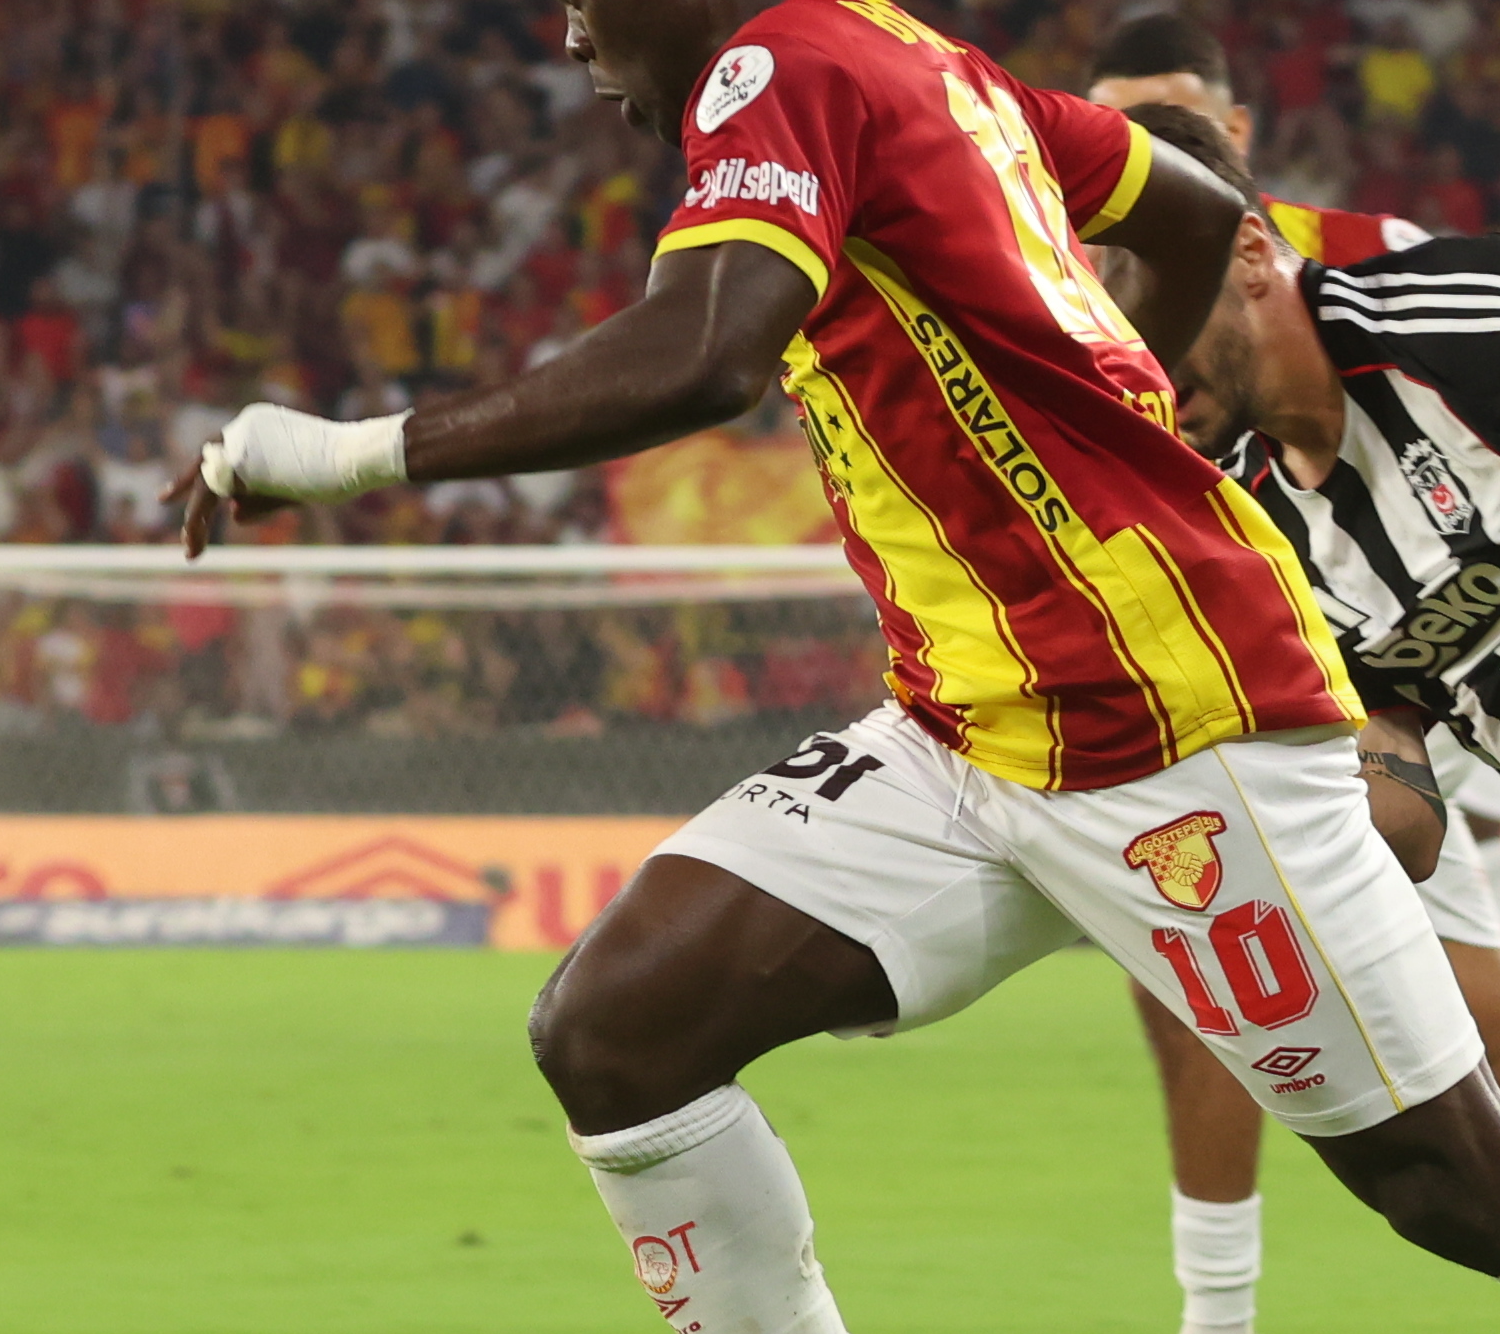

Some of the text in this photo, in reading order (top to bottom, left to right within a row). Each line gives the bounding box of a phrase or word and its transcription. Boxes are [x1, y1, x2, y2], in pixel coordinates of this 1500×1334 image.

[910, 312, 1070, 534] SOLARES
[1143, 821, 1201, 852] GÖZTEPE
[1151, 898, 1320, 1037] 10
[1270, 1072, 1326, 1095] umbro
